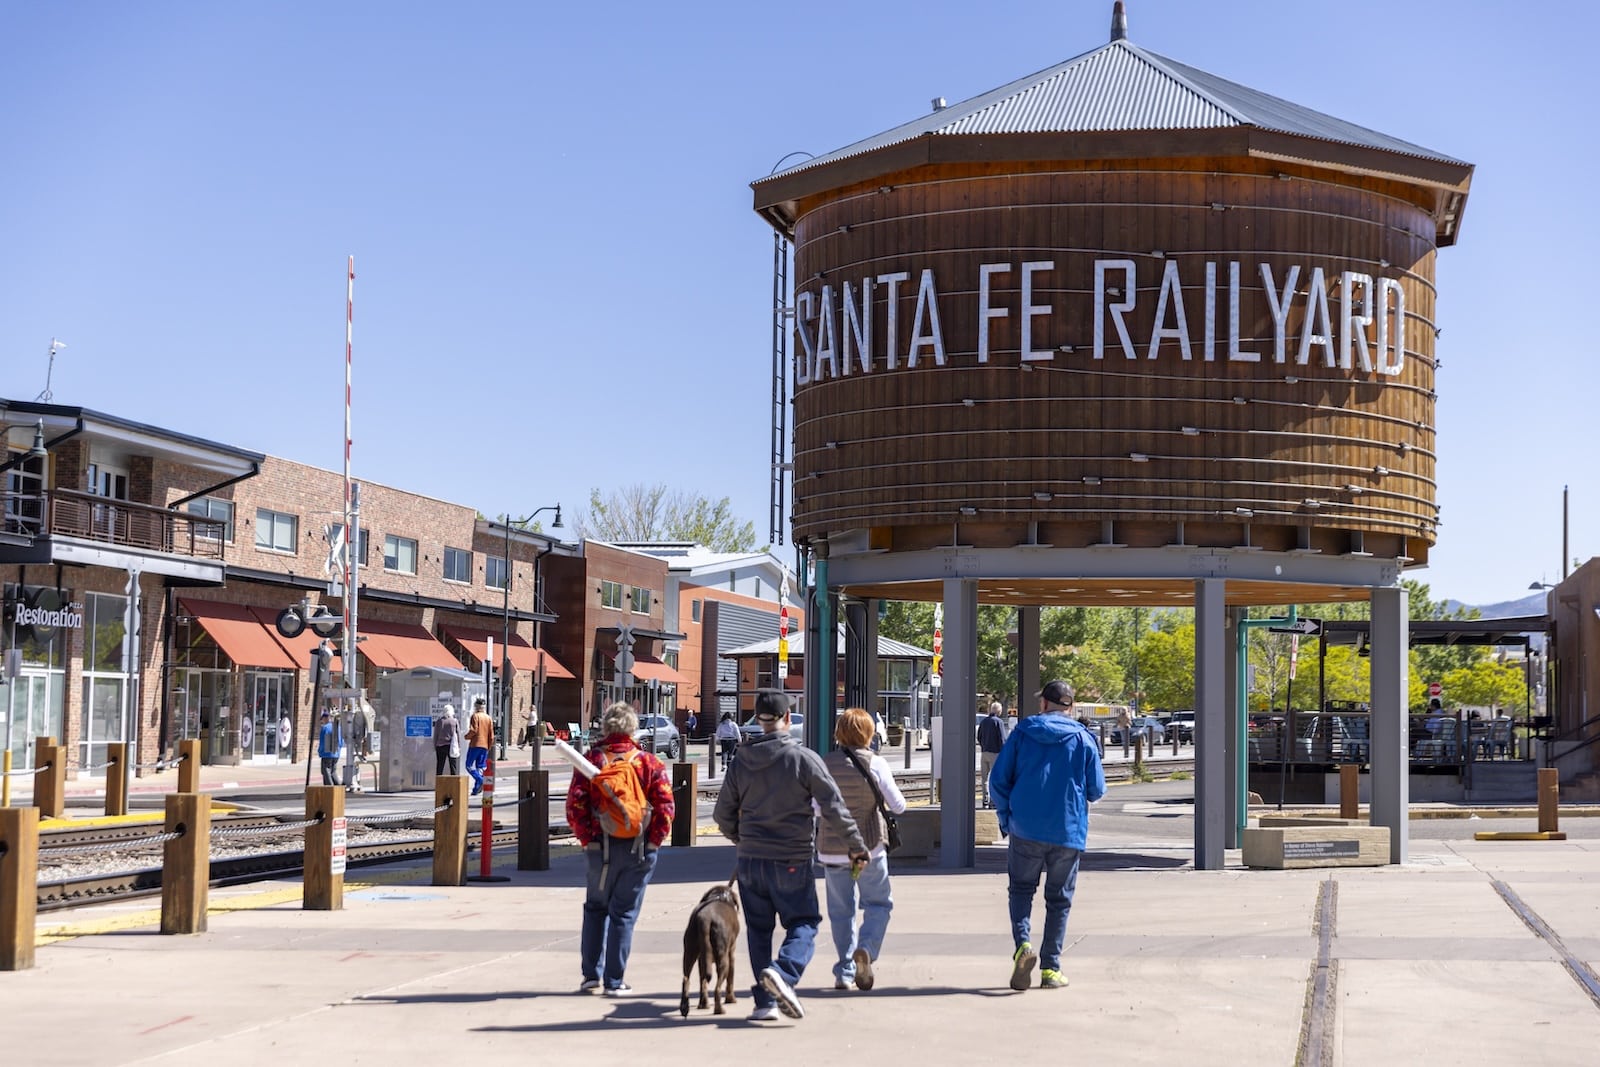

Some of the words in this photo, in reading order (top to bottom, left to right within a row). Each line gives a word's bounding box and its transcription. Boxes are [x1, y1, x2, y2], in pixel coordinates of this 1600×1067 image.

[796, 268, 947, 386] SANTA
[977, 261, 1055, 363] FE
[1093, 259, 1405, 377] RAILYARD
[15, 603, 81, 628] Restoration
